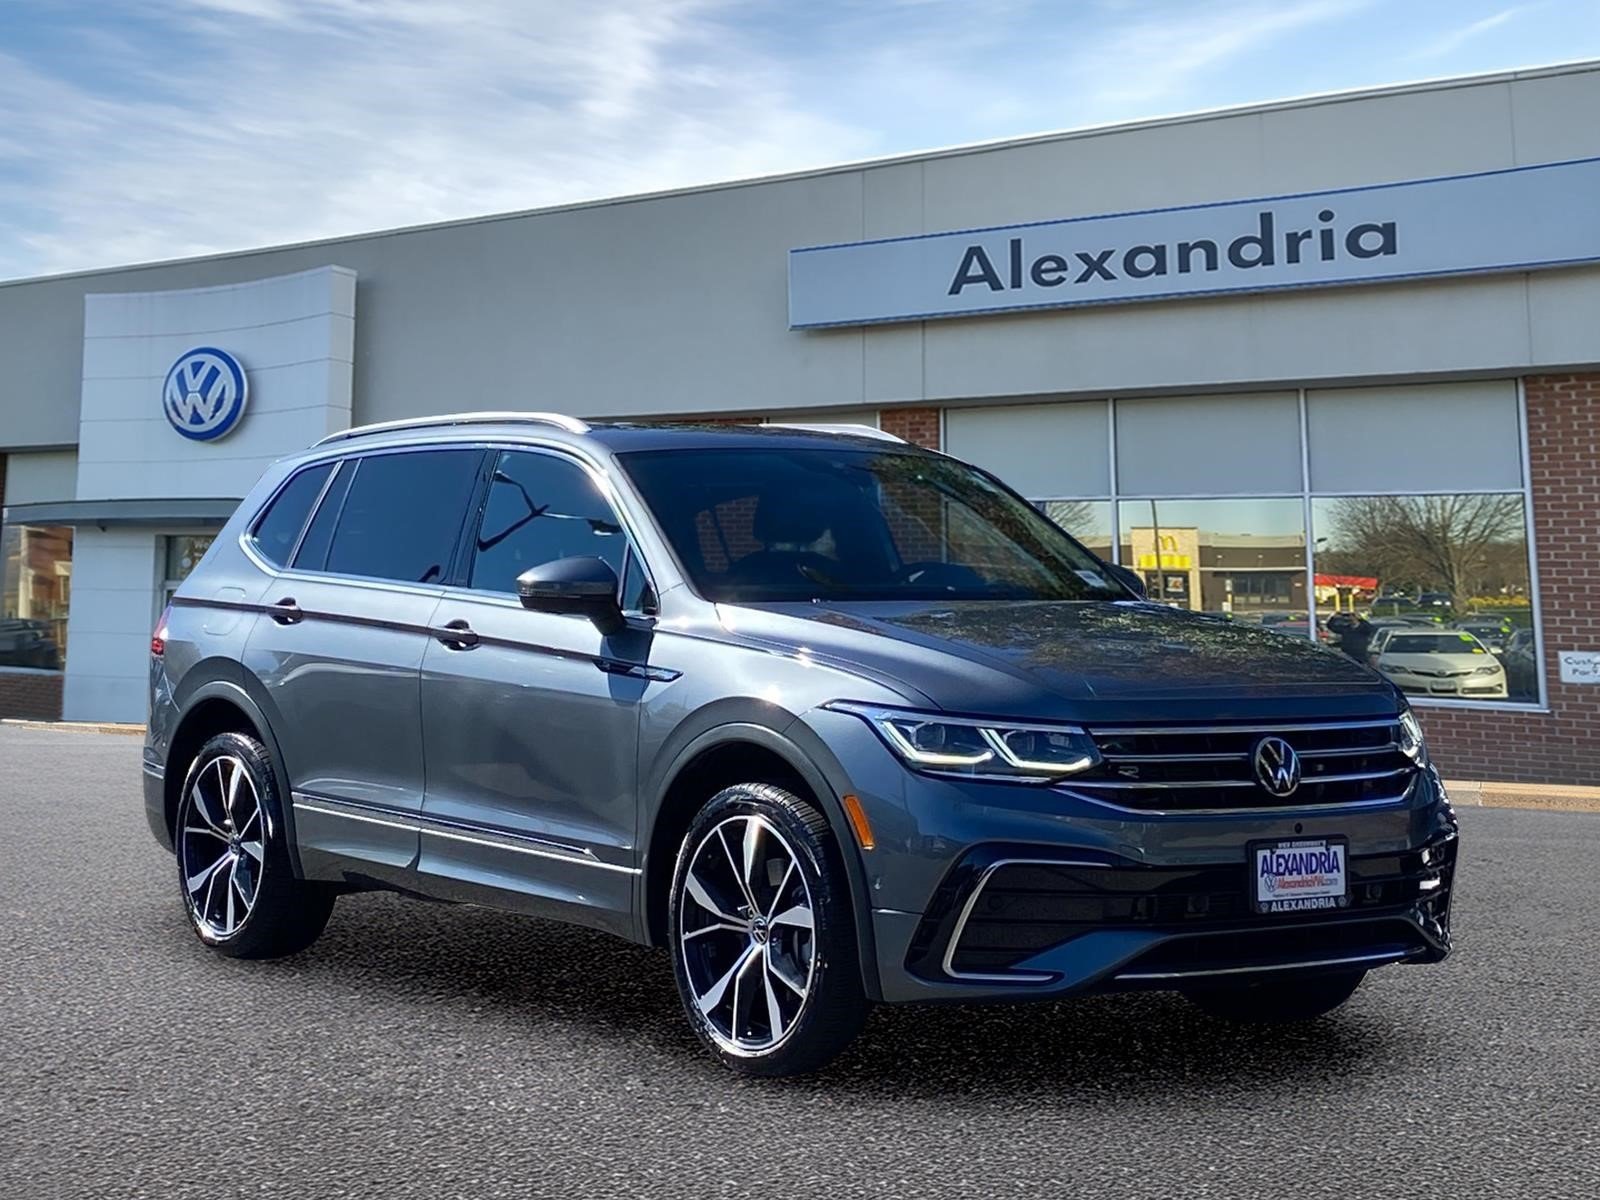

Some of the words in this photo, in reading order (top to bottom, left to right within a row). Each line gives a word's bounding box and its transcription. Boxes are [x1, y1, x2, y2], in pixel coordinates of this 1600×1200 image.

[948, 209, 1398, 295] Alexandria
[166, 351, 237, 433] VW
[1564, 656, 1598, 666] Cust
[1257, 738, 1300, 796] VW
[1260, 850, 1341, 878] ALEXANDRIA
[1270, 897, 1336, 912] ALEXANDRIA
